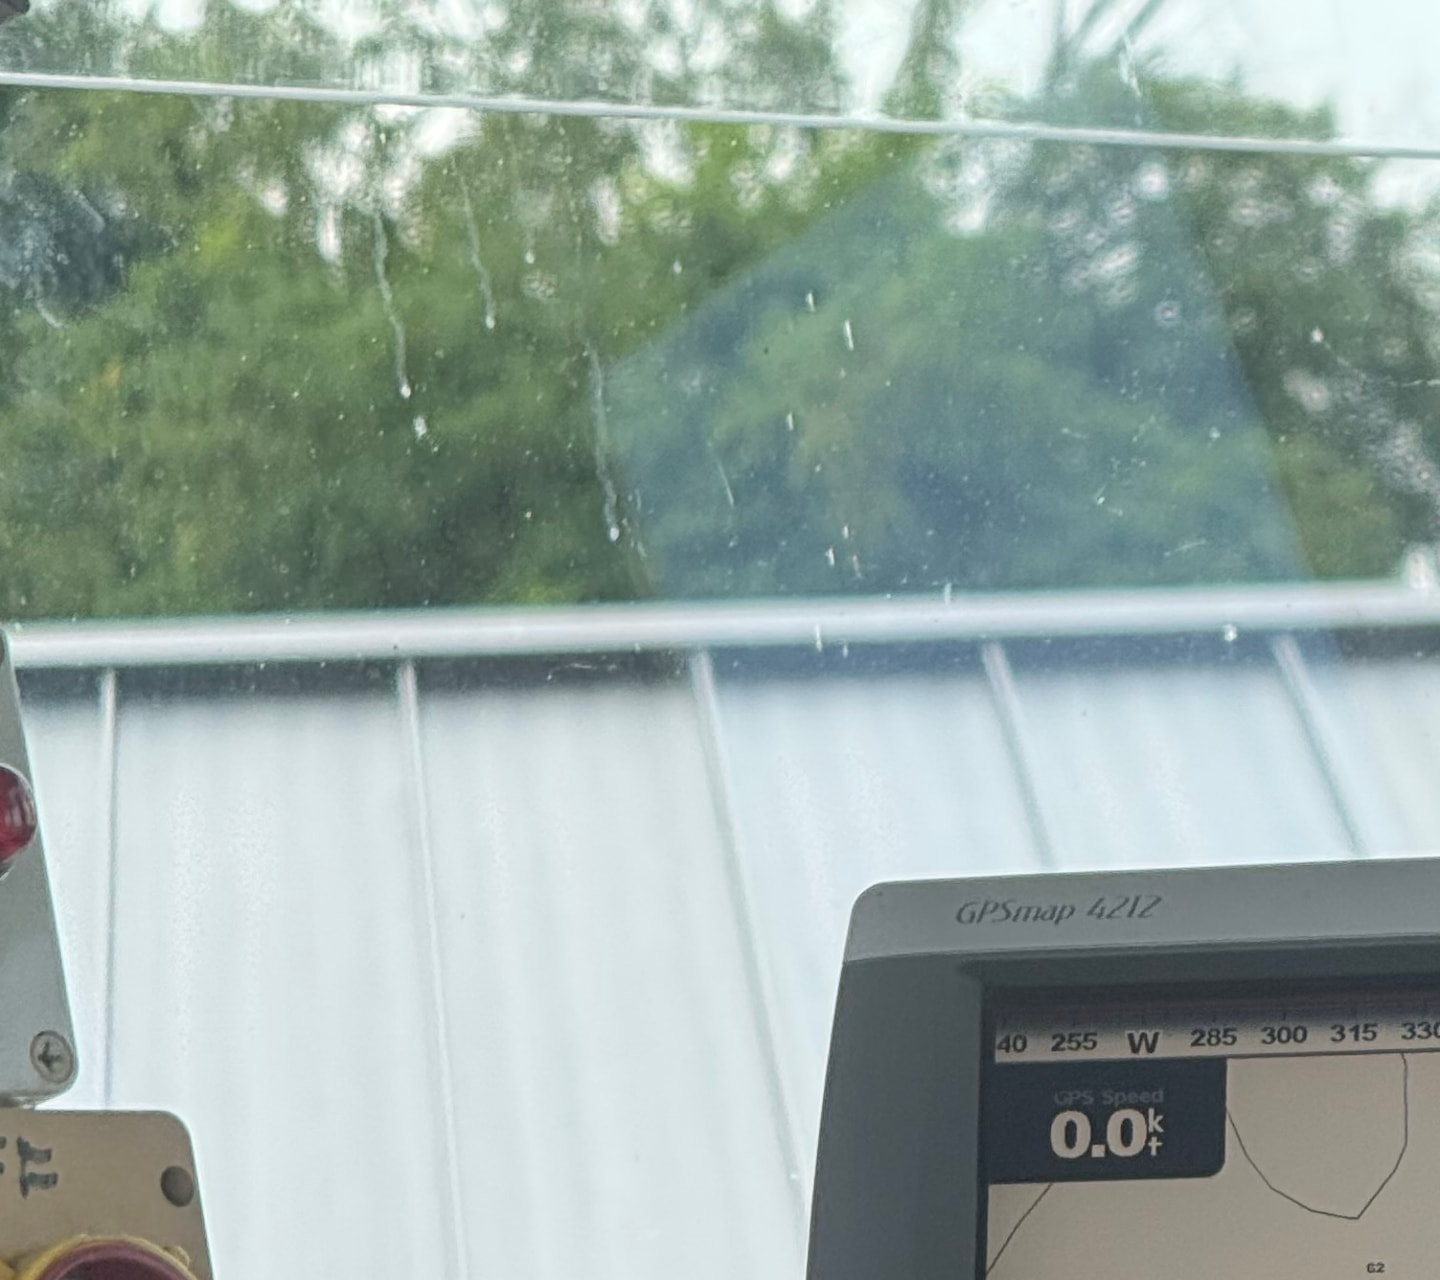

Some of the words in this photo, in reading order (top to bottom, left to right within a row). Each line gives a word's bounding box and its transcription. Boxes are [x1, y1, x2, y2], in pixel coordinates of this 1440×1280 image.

[956, 898, 1076, 925] GPSmap
[1087, 895, 1162, 920] 4212
[1051, 1032, 1098, 1052] 255
[1127, 1031, 1159, 1054] W
[1190, 1026, 1238, 1048] 285
[1261, 1024, 1308, 1045] 300
[1330, 1022, 1378, 1043] 315
[1054, 1089, 1094, 1105] GPS
[1102, 1086, 1164, 1107] Speed
[1366, 1263, 1386, 1274] 62
